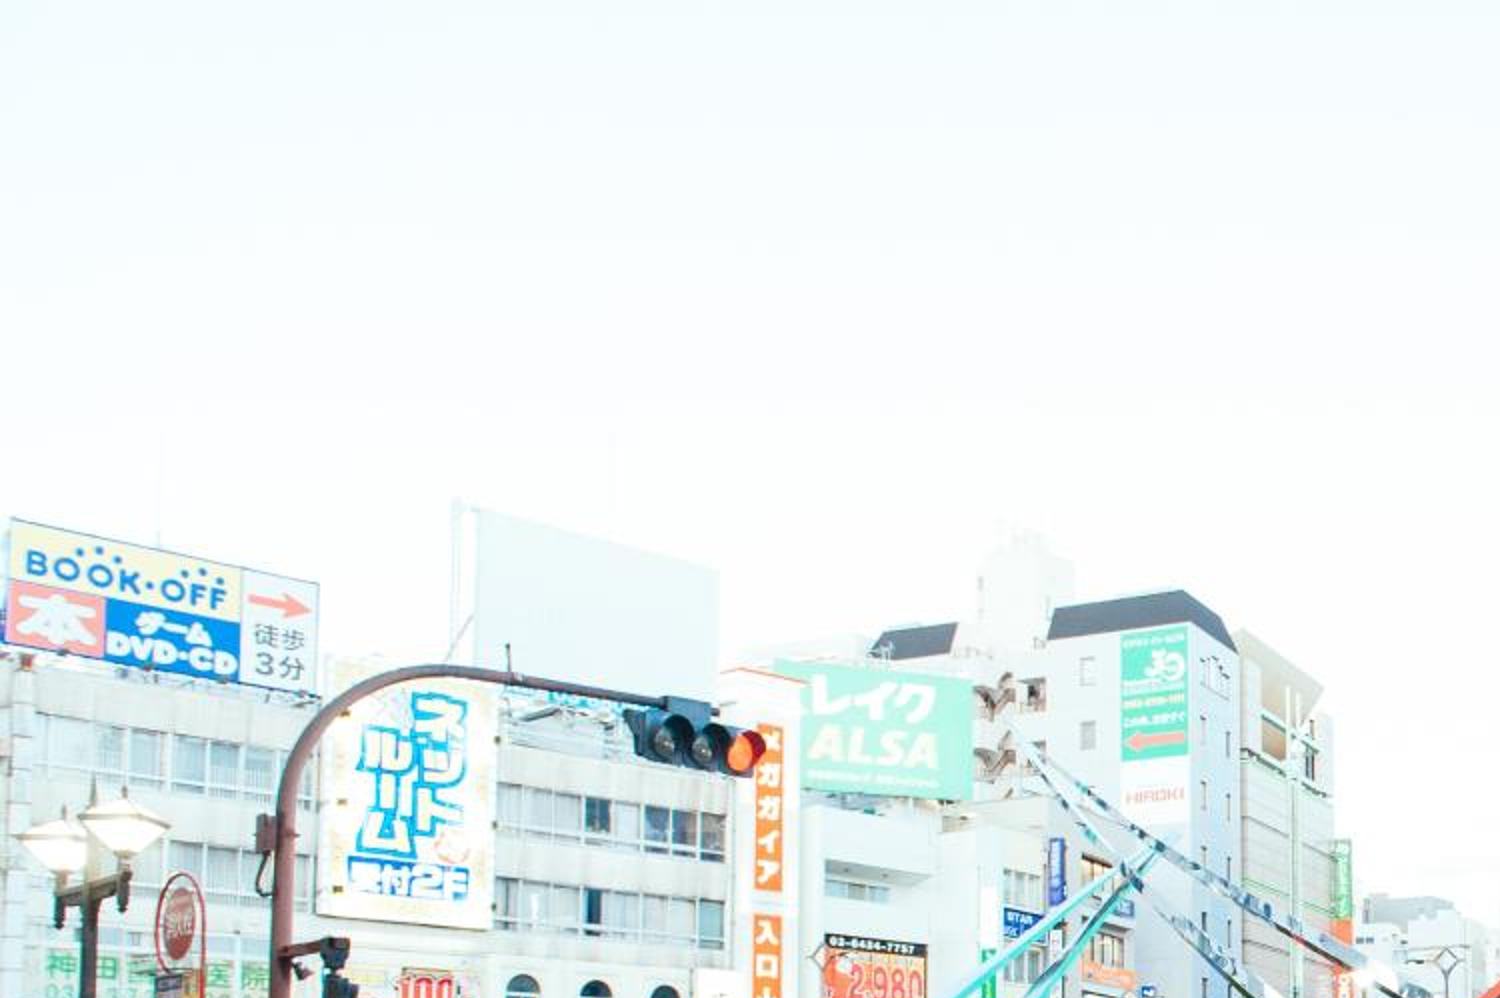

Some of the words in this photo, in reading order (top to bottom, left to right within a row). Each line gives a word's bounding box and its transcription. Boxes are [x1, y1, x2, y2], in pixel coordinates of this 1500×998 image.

[16, 593, 98, 645] 本
[254, 623, 305, 651] 徒歩
[254, 652, 305, 680] 3分
[811, 673, 937, 725] レイク
[411, 691, 468, 837] ネット
[808, 725, 940, 771] ALSA
[355, 724, 418, 860] ルーム
[754, 918, 780, 980] 入口
